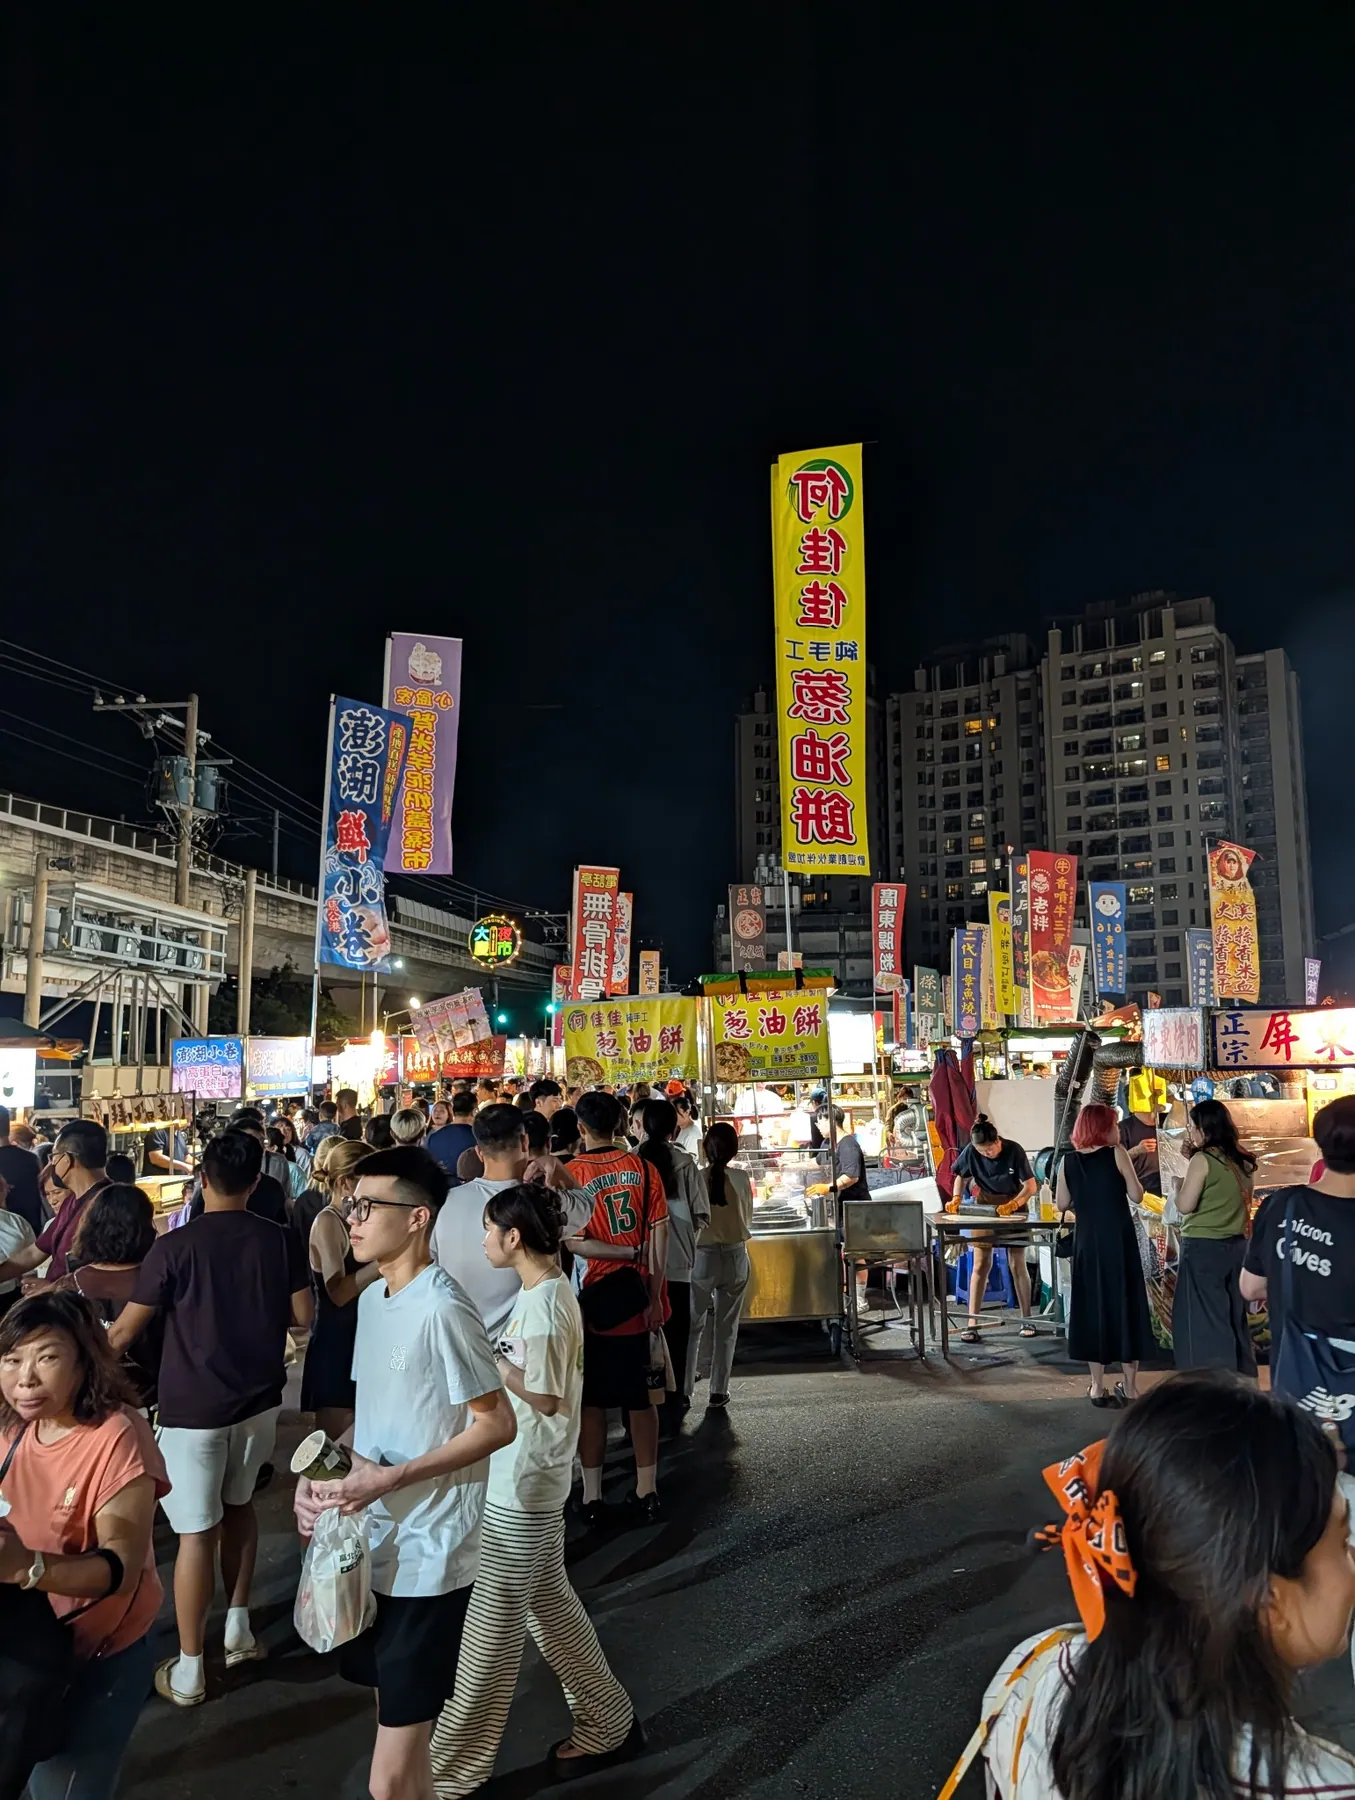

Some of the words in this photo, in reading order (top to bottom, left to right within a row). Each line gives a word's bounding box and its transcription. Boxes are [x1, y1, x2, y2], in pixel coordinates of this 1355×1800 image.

[1056, 859, 1069, 873] 牛
[1032, 896, 1049, 931] 老拌
[1216, 901, 1253, 920] 大溪
[961, 932, 977, 1015] 二代目章魚燒
[1220, 1012, 1250, 1063] 正宗
[176, 1042, 239, 1063] 澎湖小卷
[785, 1054, 796, 1062] 55
[657, 1070, 668, 1078] 55
[603, 1189, 637, 1236] 13
